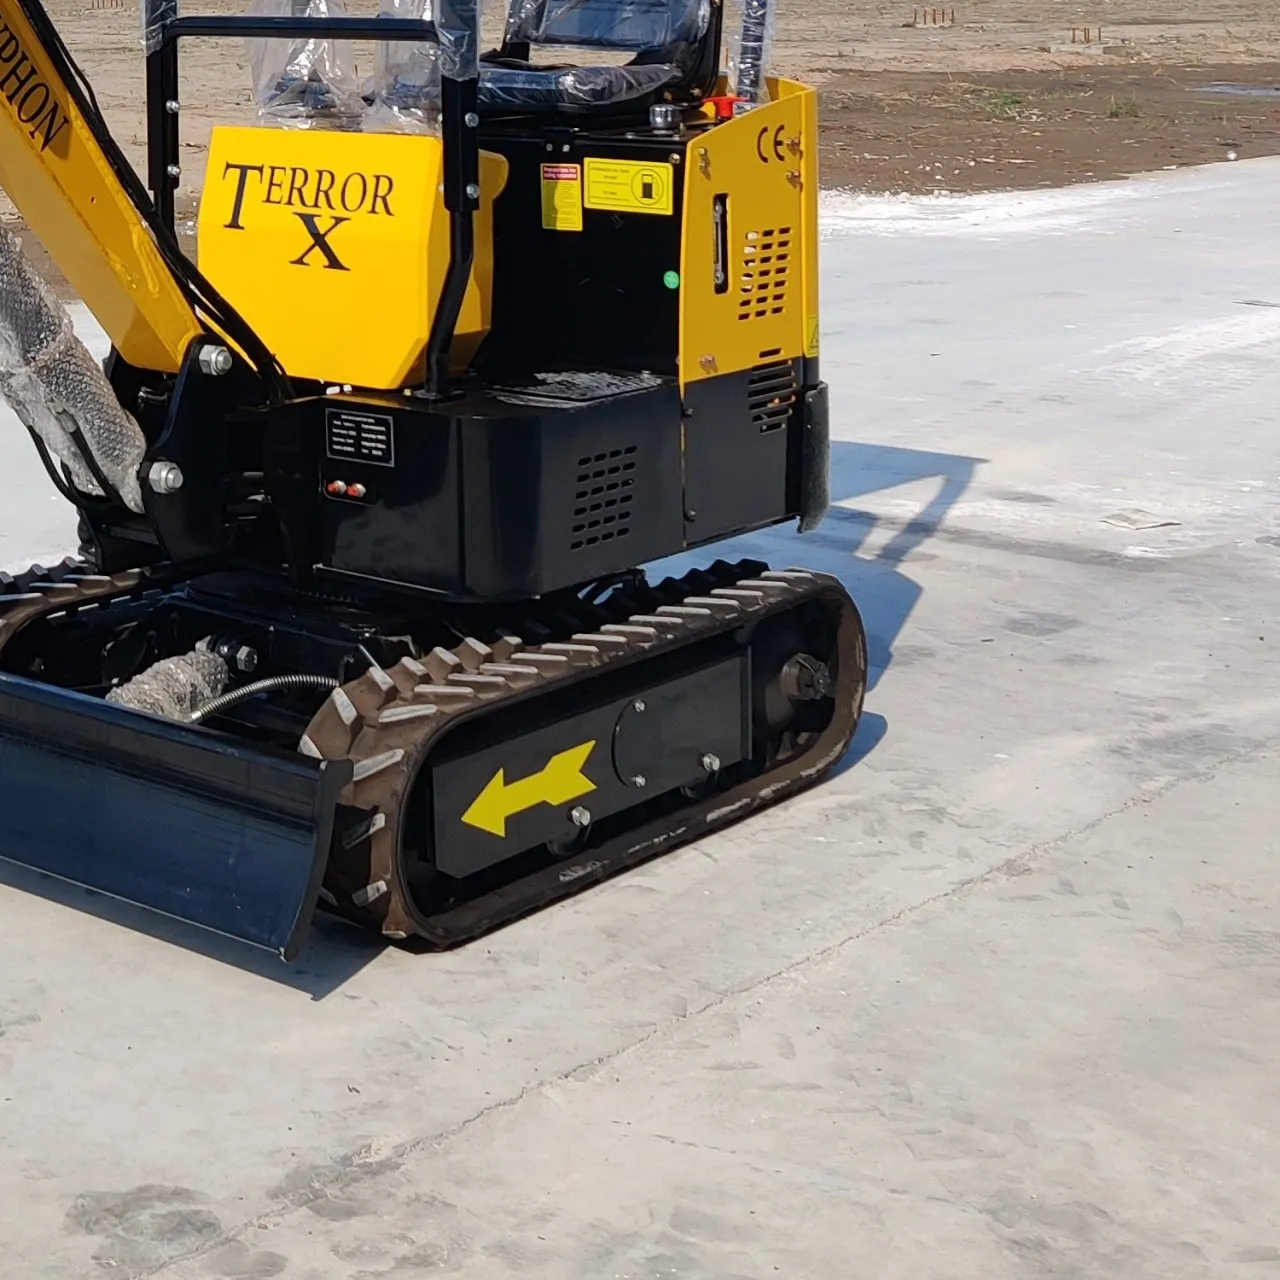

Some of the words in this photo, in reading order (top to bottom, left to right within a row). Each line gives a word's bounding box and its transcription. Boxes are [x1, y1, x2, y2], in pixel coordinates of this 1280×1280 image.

[757, 124, 786, 163] CE
[223, 161, 395, 230] TERROR
[289, 212, 351, 271] X
